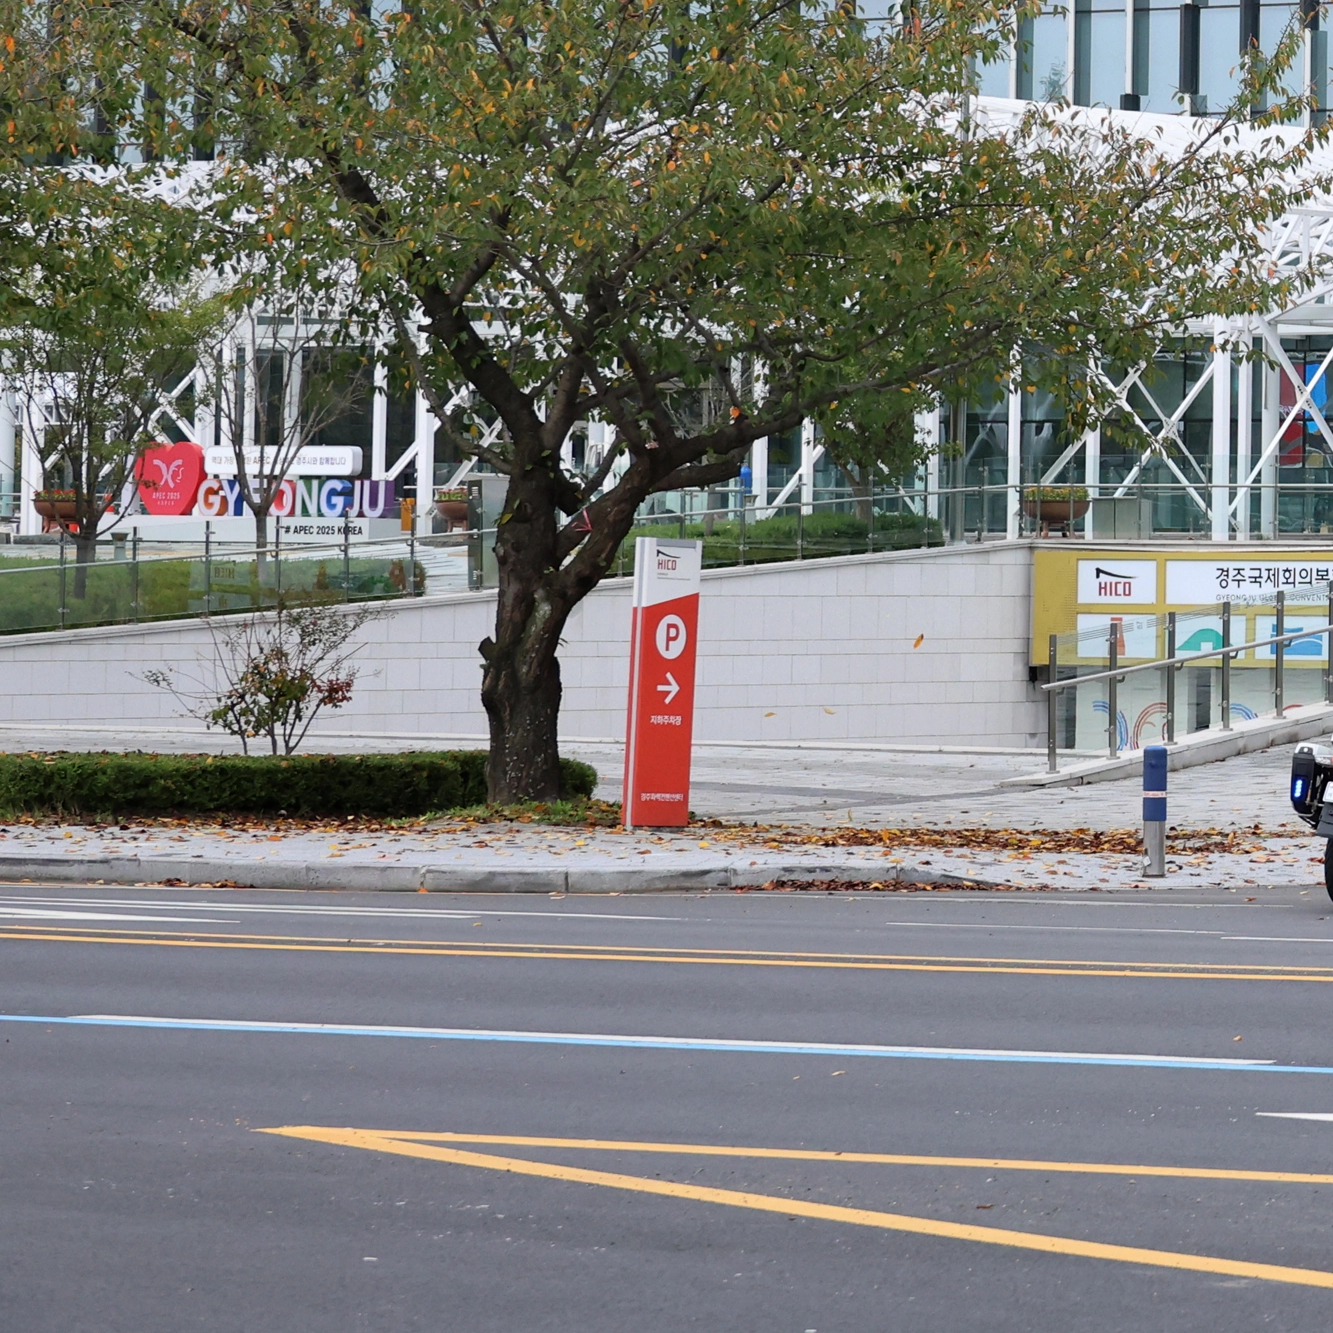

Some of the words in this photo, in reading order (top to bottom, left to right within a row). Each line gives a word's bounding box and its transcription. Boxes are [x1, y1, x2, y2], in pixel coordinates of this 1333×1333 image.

[293, 525, 314, 535] APEC
[316, 525, 335, 535] 2025
[657, 559, 677, 571] HICO
[1098, 581, 1132, 597] HICO
[650, 715, 682, 726] 지하주차장
